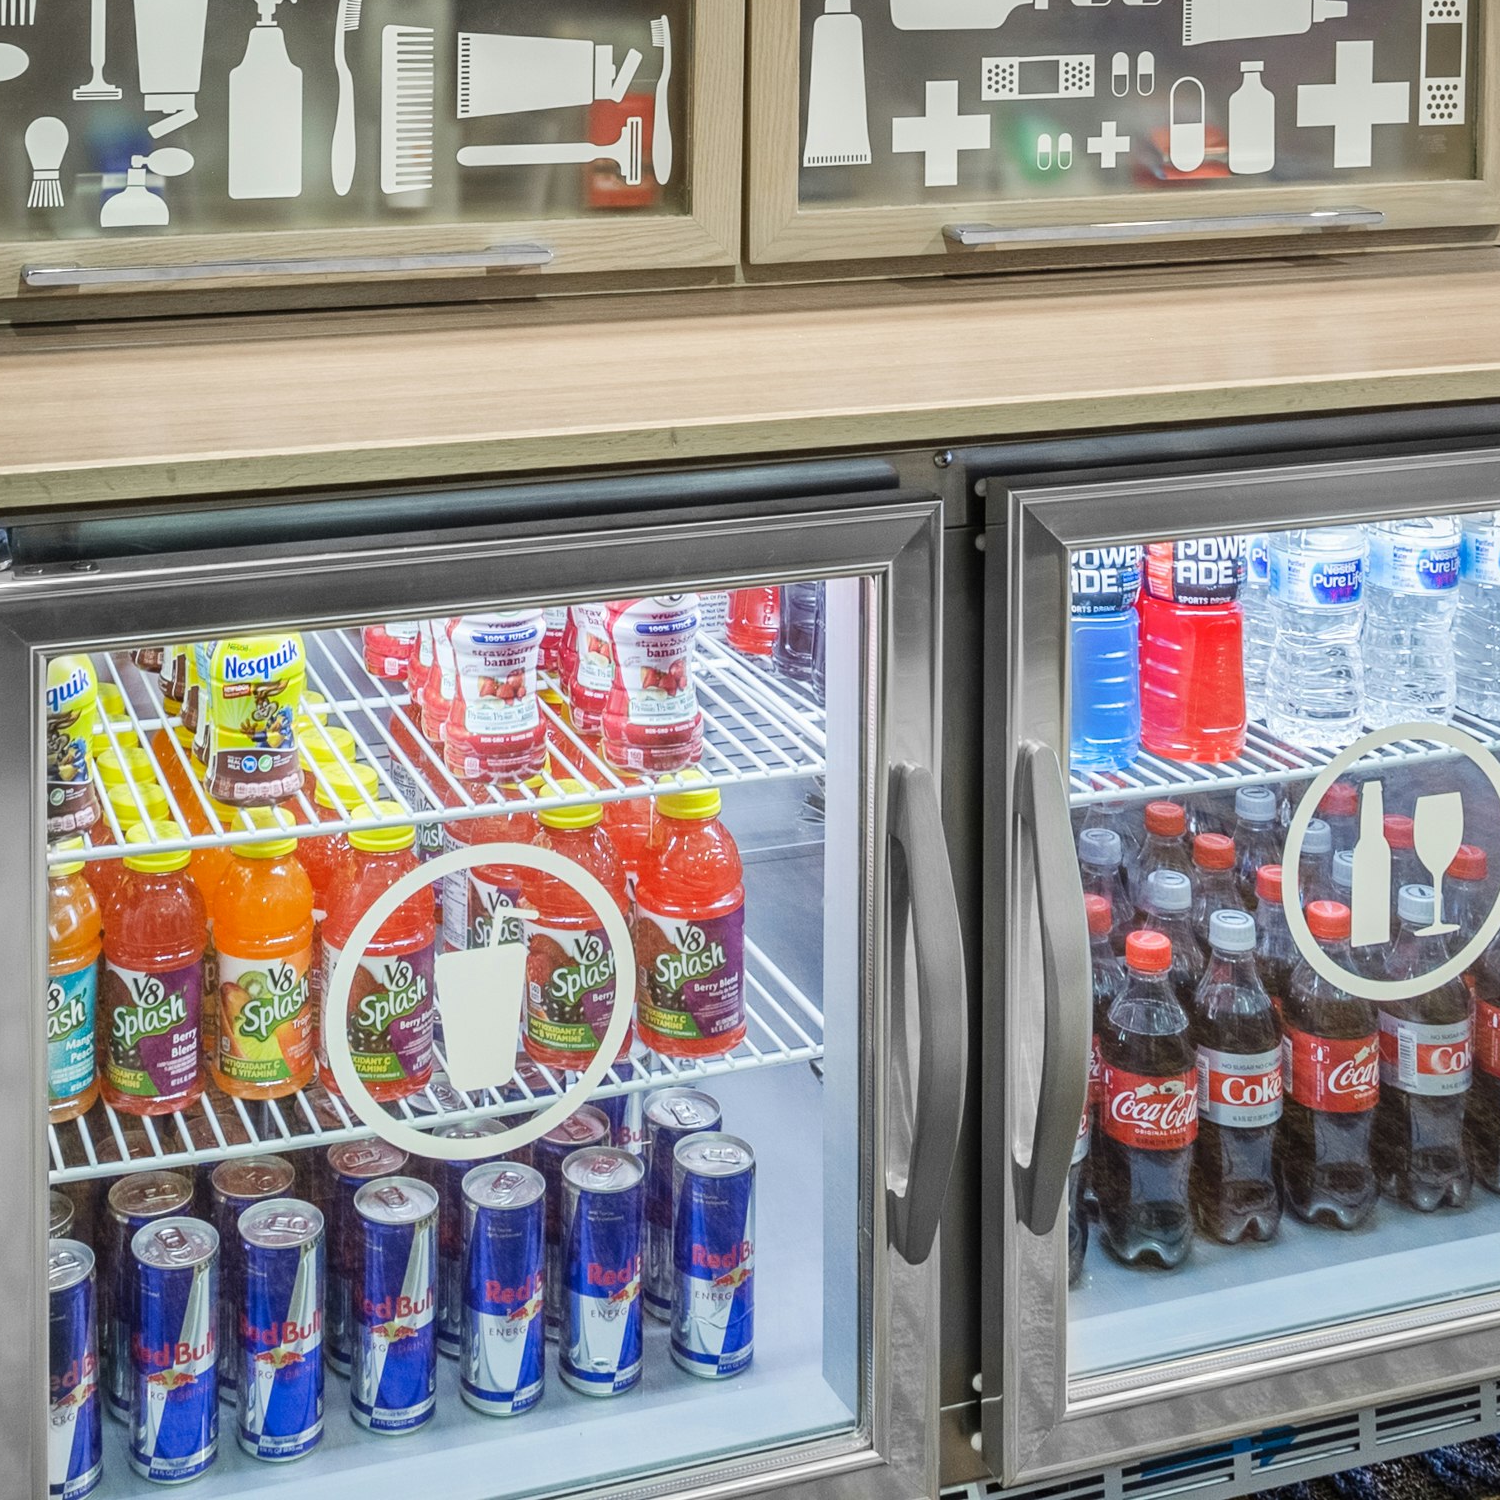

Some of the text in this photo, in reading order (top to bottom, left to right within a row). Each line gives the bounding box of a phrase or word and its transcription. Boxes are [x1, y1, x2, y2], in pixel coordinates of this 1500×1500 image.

[1312, 573, 1346, 588] Pure
[1419, 560, 1449, 573] Pure
[1178, 596, 1209, 604] SPORTS
[484, 631, 530, 643] 100% JUICE
[648, 619, 693, 633] 100% JUICE
[225, 640, 298, 680] Nesquik
[484, 654, 527, 668] banana
[646, 645, 688, 658] banana
[47, 668, 89, 712] quik
[574, 935, 599, 962] V8
[676, 925, 701, 952] V8
[268, 961, 294, 992] V8
[383, 961, 411, 991] V8
[655, 942, 727, 991] Splash
[133, 973, 161, 1006] V8
[694, 981, 718, 994] Berry
[719, 972, 739, 987] Blend
[48, 999, 86, 1037] ash
[243, 976, 310, 1037] Splash
[358, 976, 428, 1031] Splash
[113, 994, 188, 1046] Splash
[400, 1017, 421, 1031] Berry
[171, 1040, 197, 1058] Blend
[173, 1028, 197, 1045] Berry
[238, 1067, 277, 1078] VITAMINS
[1431, 1042, 1473, 1075] Cok
[1221, 1076, 1283, 1106] Coke
[1112, 1088, 1198, 1131] Coca-Cola
[1134, 1126, 1188, 1137] ORIGINAL TASTE
[587, 1255, 632, 1285] Red
[692, 1243, 737, 1269] Red
[396, 1287, 434, 1319] Bull
[485, 1273, 533, 1304] Red
[280, 1308, 322, 1345] Bull
[174, 1330, 216, 1367] Bull
[50, 1362, 80, 1390] ed
